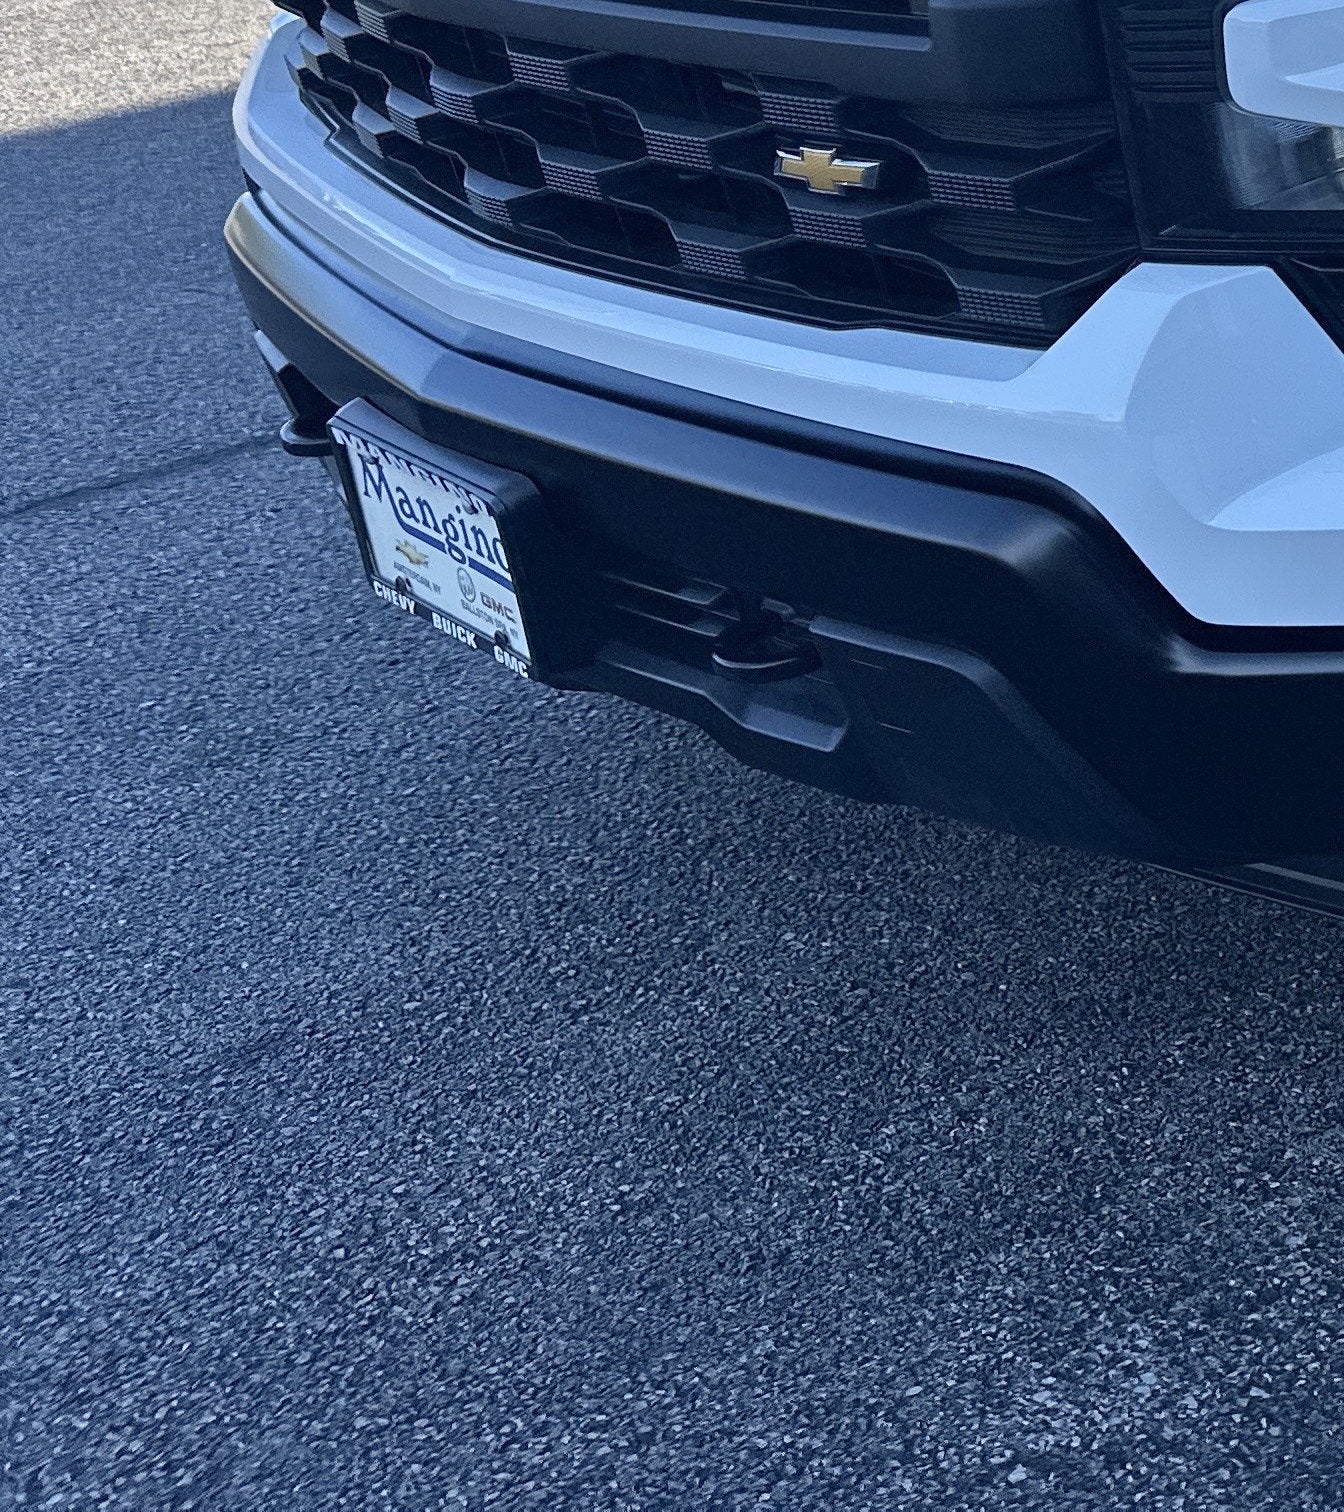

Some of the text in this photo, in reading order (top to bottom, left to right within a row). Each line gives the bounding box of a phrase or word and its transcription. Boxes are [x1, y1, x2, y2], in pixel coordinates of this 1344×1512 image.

[373, 579, 529, 679] CHEVY BUICK GMC
[480, 592, 516, 624] GMC
